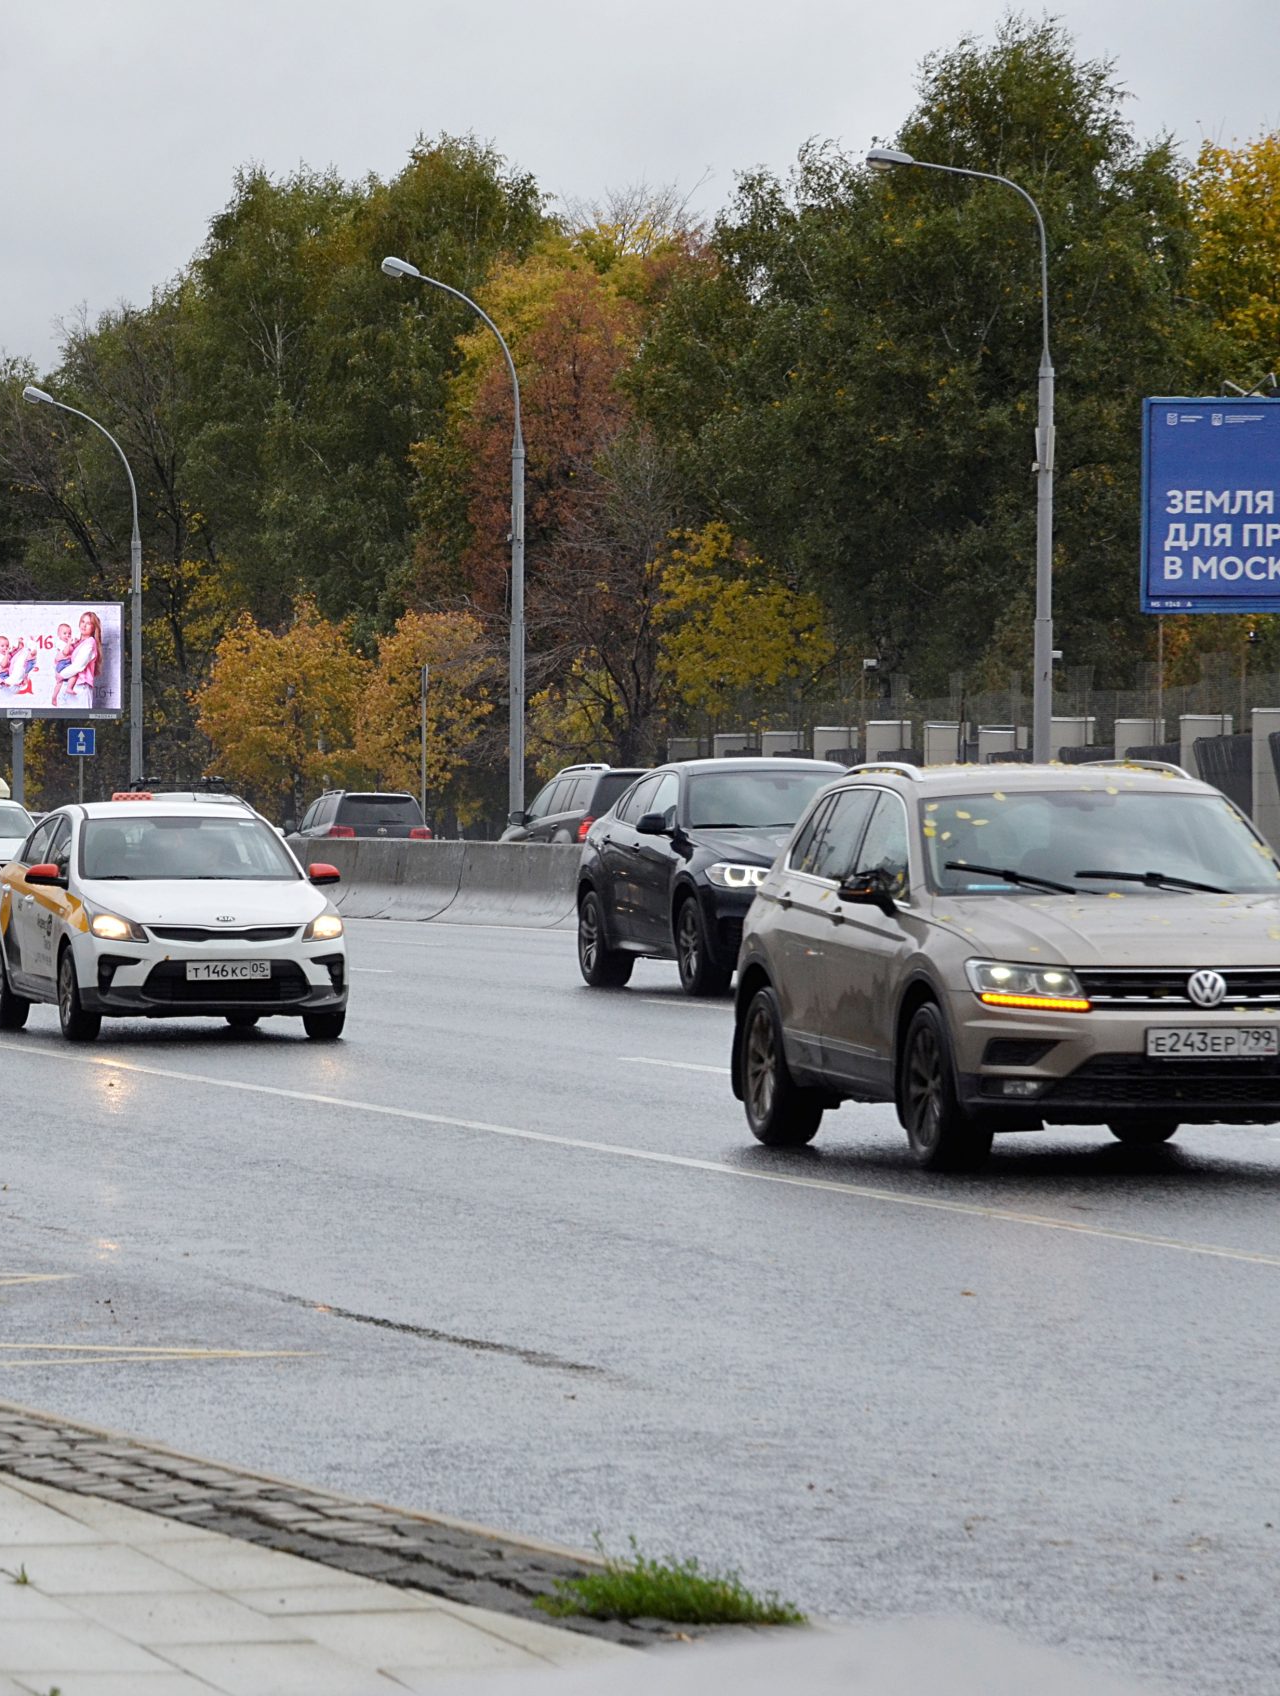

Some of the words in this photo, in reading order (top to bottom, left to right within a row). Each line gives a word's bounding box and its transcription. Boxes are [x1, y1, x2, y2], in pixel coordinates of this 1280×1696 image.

[1166, 490, 1274, 514] ЗЕМЛЯ
[1164, 523, 1232, 551] ДЛЯ
[1242, 524, 1280, 547] ПР
[1164, 556, 1183, 580] В
[192, 964, 248, 978] Т146КС
[251, 962, 266, 973] 05
[1154, 1032, 1236, 1053] Е243ЕР
[1239, 1030, 1272, 1047] 799
